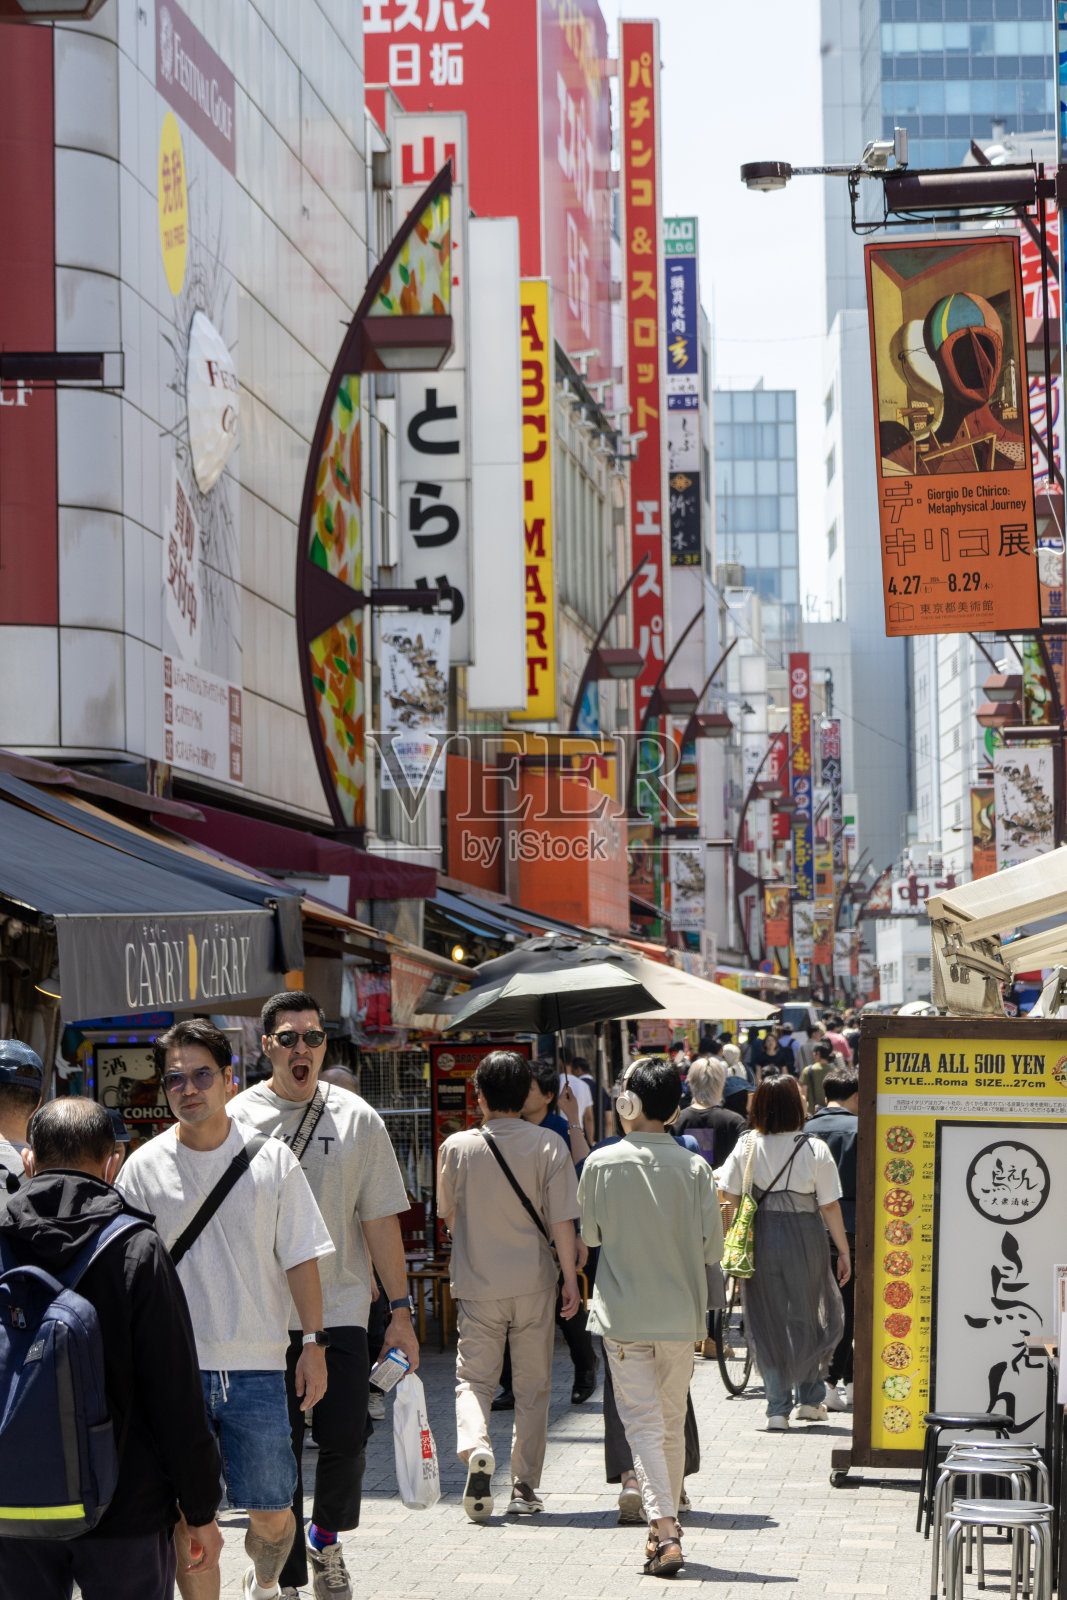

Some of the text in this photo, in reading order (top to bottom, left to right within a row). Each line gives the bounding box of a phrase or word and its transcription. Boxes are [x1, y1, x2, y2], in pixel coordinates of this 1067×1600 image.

[628, 51, 659, 428] パチンコ&スロット
[927, 484, 1011, 502] Giorgio De Chirico:
[928, 499, 1027, 517] Metaphysical Journey
[888, 575, 921, 596] 4.27
[948, 571, 981, 593] 8.29
[920, 600, 994, 615] 東京都美術館
[125, 936, 251, 1008] CARRY CARRY
[884, 1052, 1046, 1075] PIZZA ALL 500 YEN
[885, 1076, 1046, 1088] STYLE...Roma SIZE...27cm
